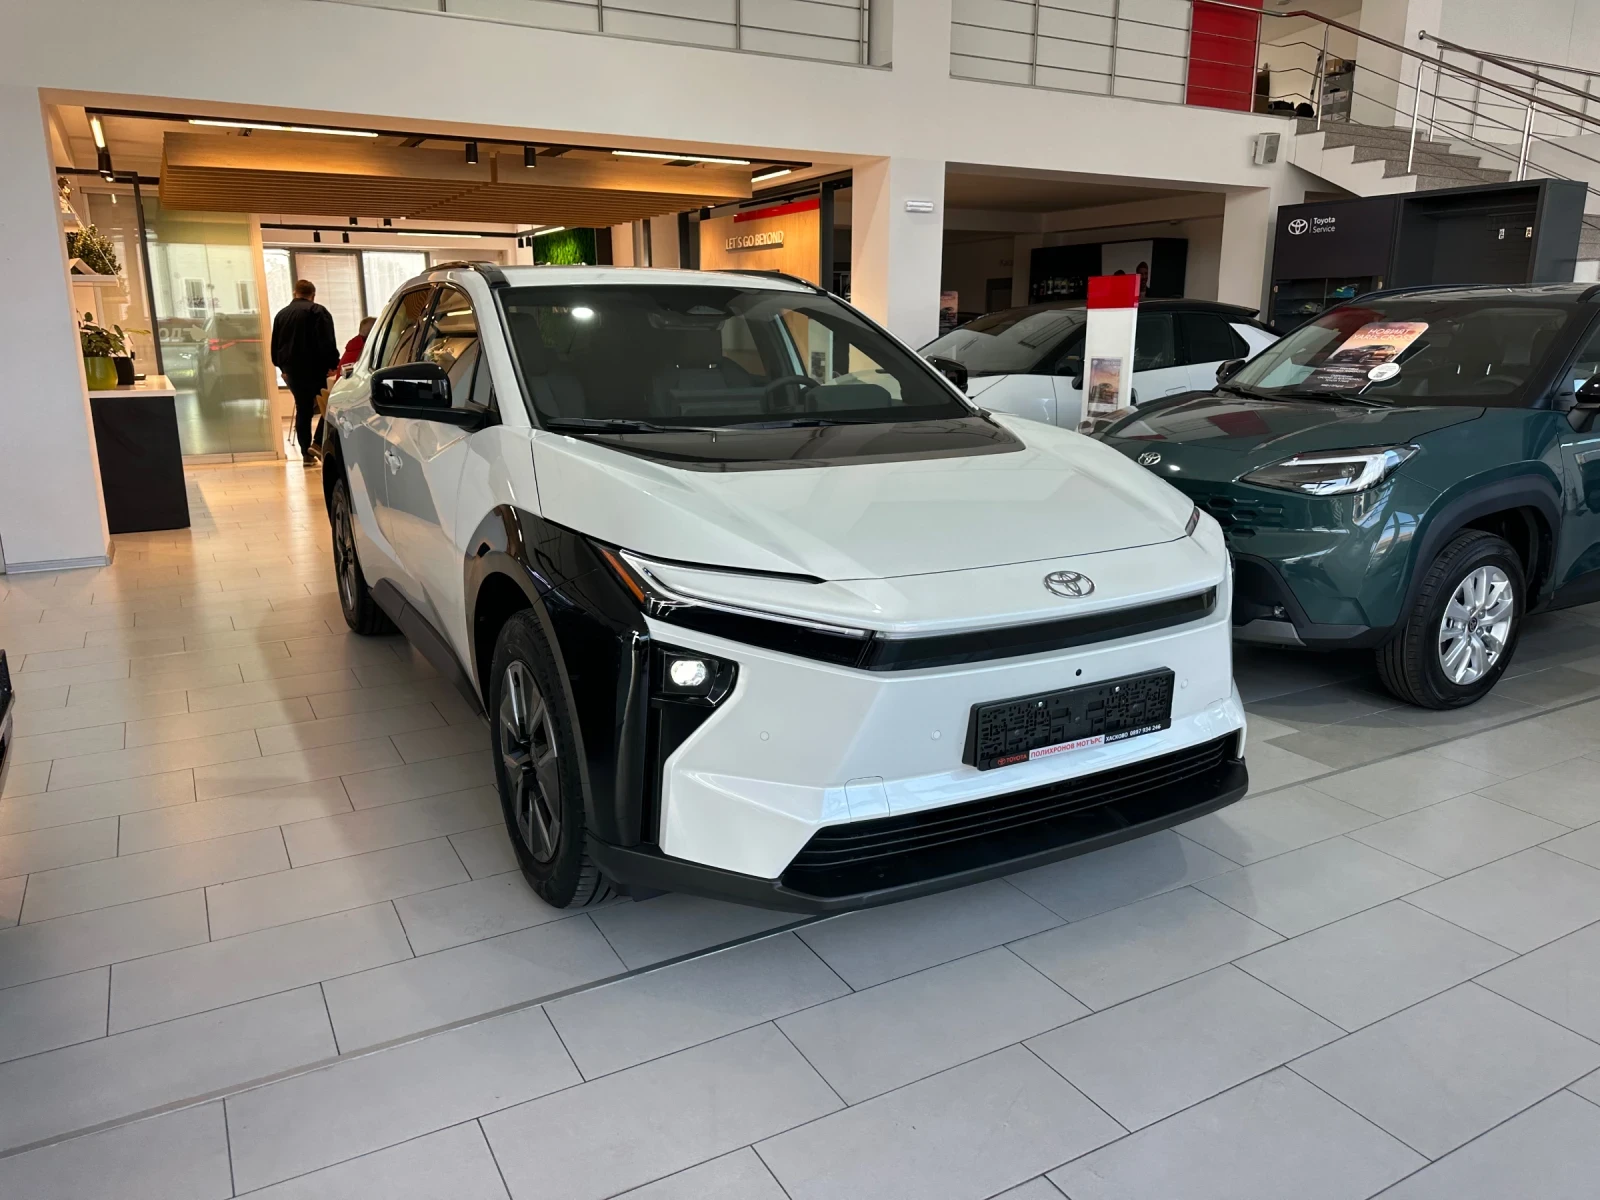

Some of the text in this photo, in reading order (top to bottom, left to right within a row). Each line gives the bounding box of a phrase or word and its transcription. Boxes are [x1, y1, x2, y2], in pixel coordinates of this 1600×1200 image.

[1313, 216, 1336, 226] Toyota
[1312, 225, 1336, 234] Service
[743, 235, 755, 247] GO
[755, 231, 783, 245] BEYOND
[1031, 742, 1075, 758] ПОЛИХРОНОВ
[1076, 736, 1103, 748] МОТЪРС
[1106, 732, 1128, 742] ХАСКОВО
[1006, 754, 1027, 763] TOYOTA
